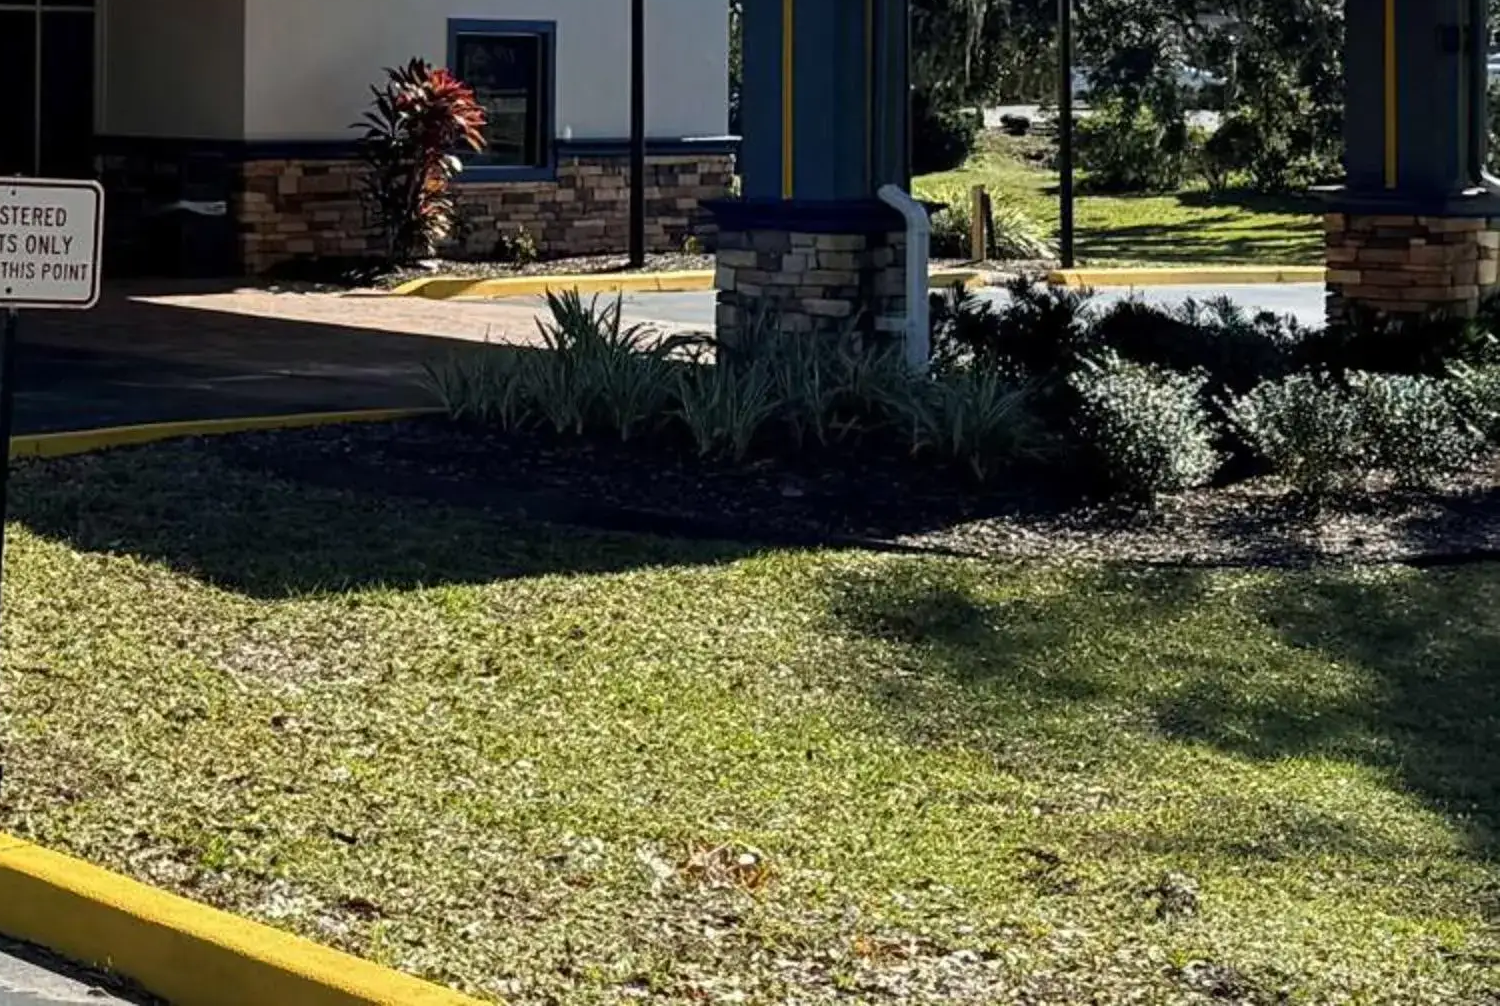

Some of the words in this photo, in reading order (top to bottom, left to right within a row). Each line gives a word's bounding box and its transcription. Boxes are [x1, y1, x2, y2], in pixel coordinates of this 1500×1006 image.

[25, 235, 73, 255] ONLY
[1, 262, 35, 279] THIS
[41, 263, 88, 280] POINT
